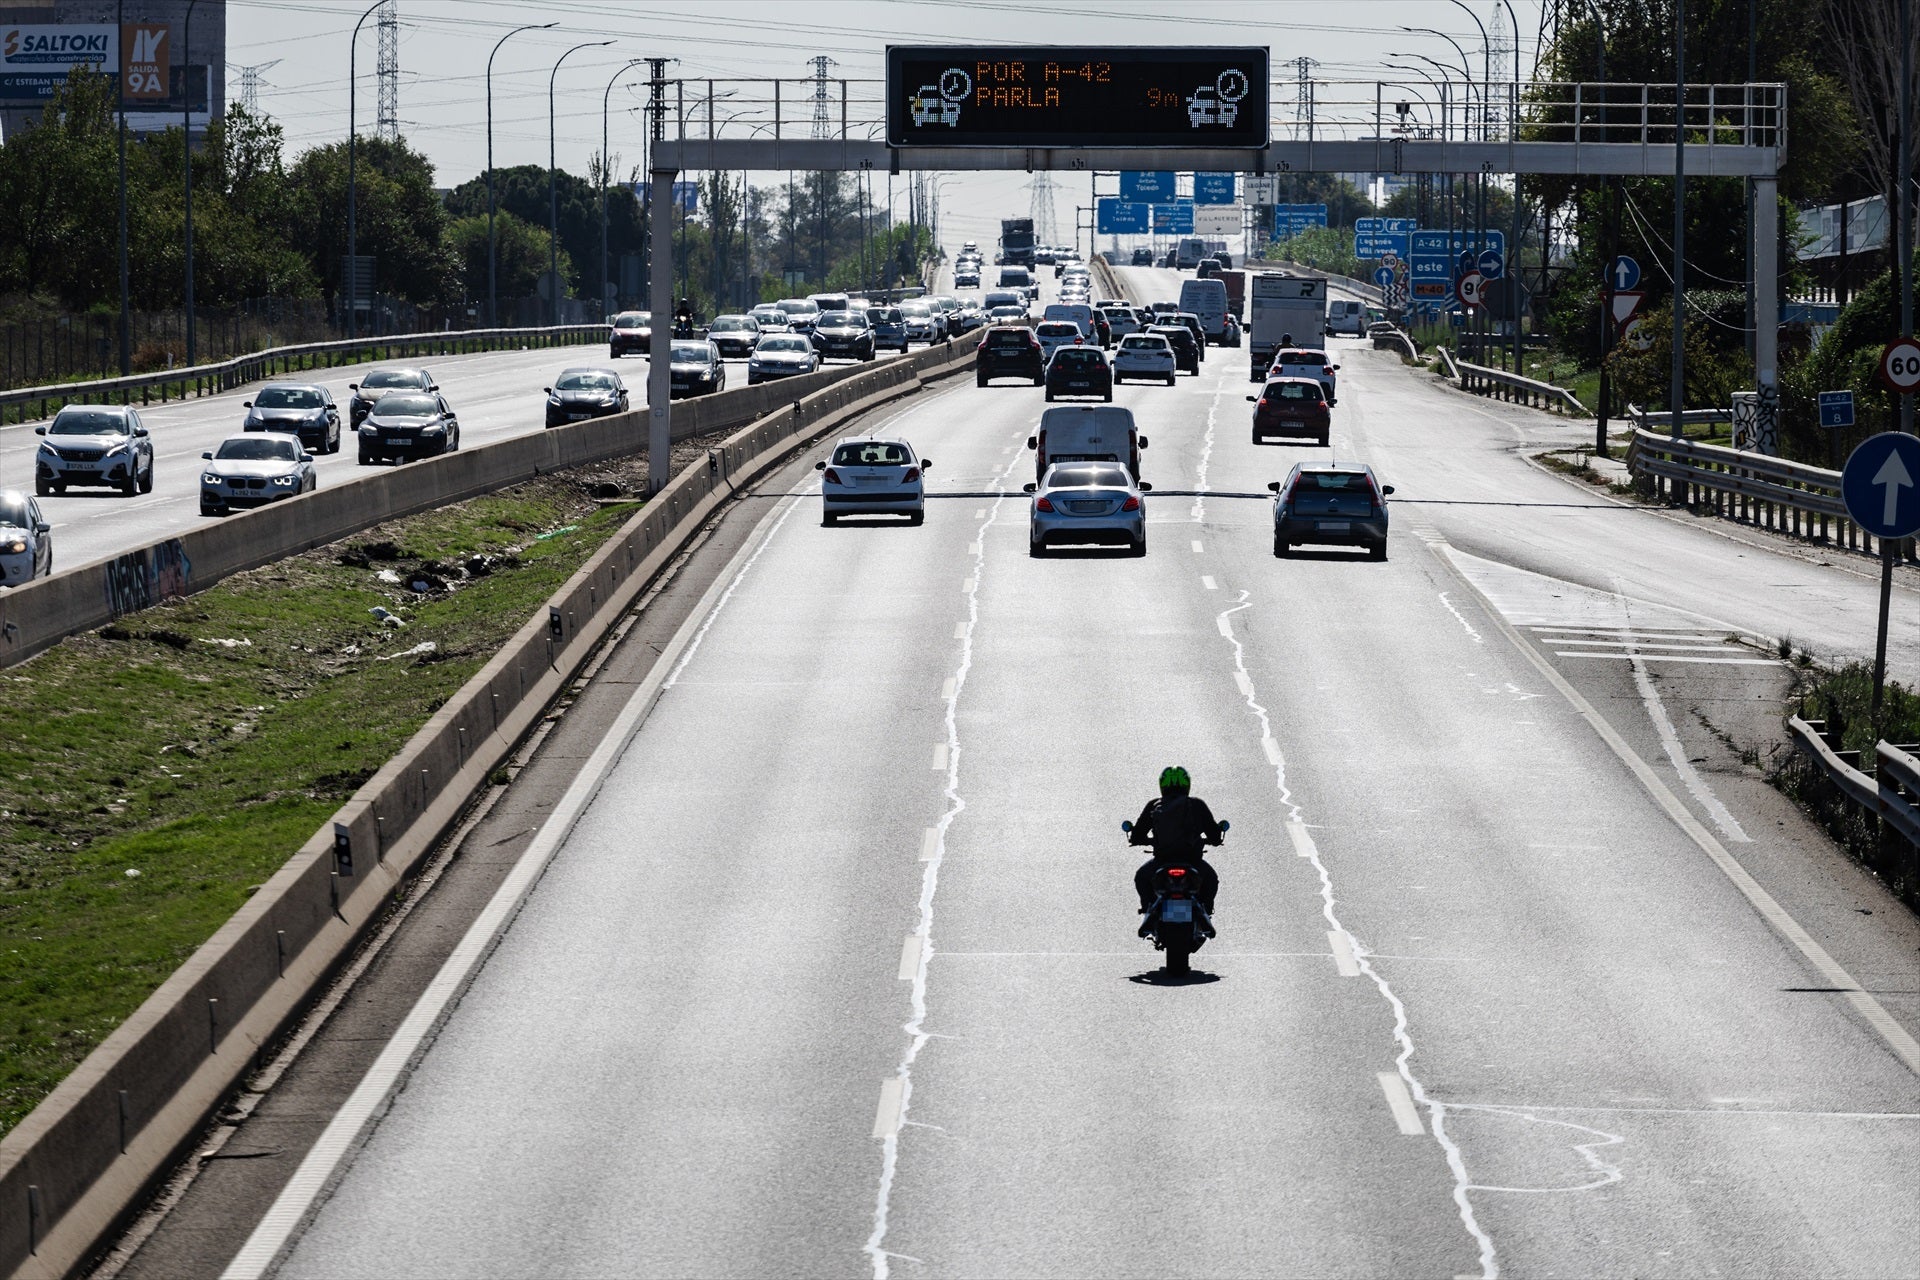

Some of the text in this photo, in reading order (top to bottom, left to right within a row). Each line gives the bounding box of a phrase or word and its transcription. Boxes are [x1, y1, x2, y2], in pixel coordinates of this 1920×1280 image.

[23, 34, 108, 52] SALTOKI
[128, 65, 160, 73] SALIDA
[977, 61, 1110, 82] POR A-42
[15, 78, 50, 86] ESTEBAN
[128, 73, 162, 93] 9A
[977, 86, 1059, 107] PARLA
[1417, 239, 1442, 248] A-42
[1383, 257, 1396, 266] 90
[1416, 261, 1443, 272] este
[1416, 284, 1443, 294] M-40
[1891, 356, 1919, 376] 60
[1826, 394, 1848, 402] A-42
[1833, 412, 1842, 423] 8
